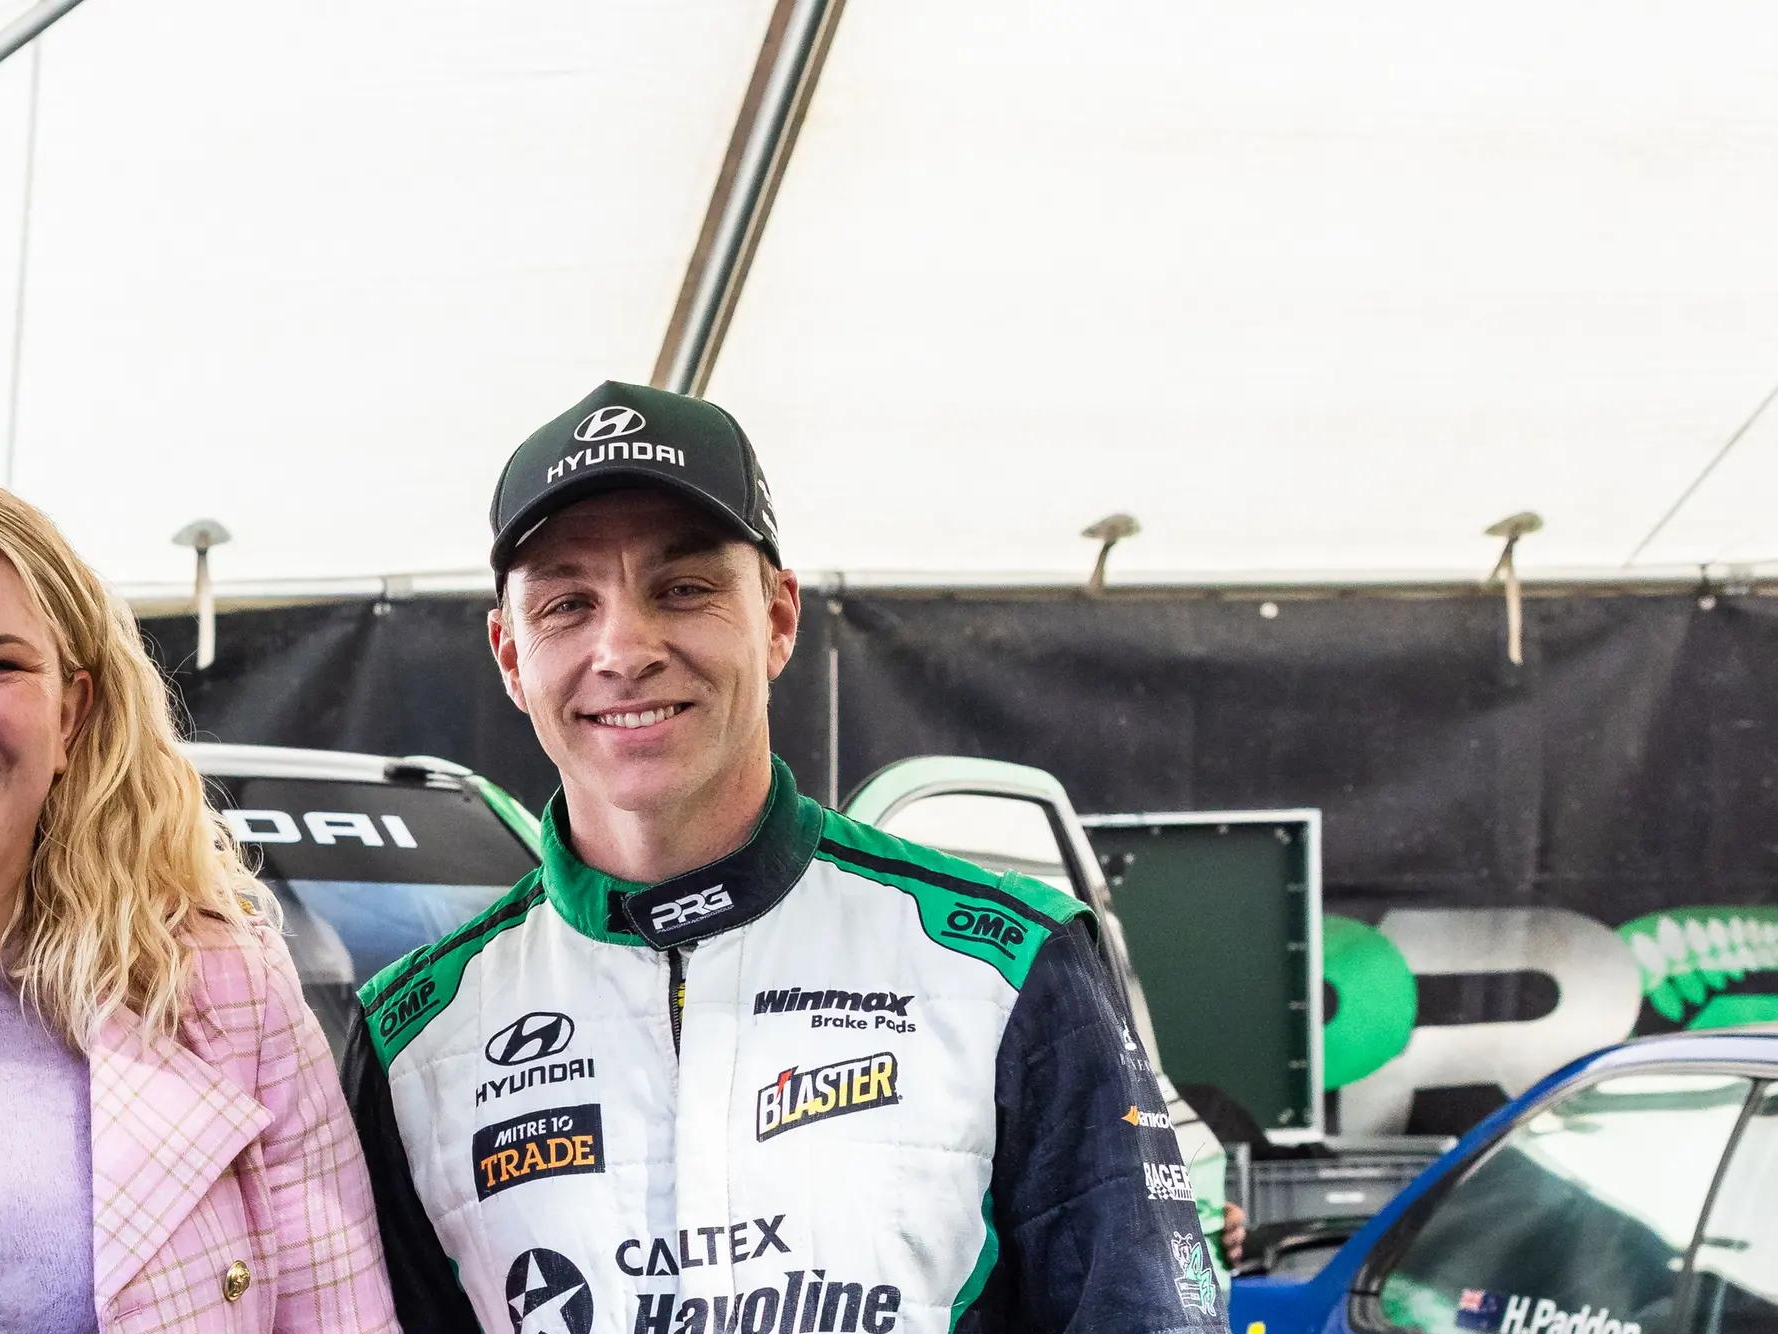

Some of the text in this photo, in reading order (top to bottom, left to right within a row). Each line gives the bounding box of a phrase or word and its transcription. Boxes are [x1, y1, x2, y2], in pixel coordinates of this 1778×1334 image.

[546, 442, 685, 484] HYUNDAI
[222, 808, 419, 849] DAI
[650, 883, 734, 930] PRG
[946, 909, 1025, 946] OMP
[380, 980, 436, 1037] OMP
[753, 986, 916, 1017] Winmax
[810, 1014, 917, 1034] Brake Pads
[475, 1058, 596, 1108] HYUNDAI
[494, 1114, 574, 1149] MITRE 10
[480, 1134, 595, 1188] TRADE
[615, 1213, 793, 1277] CALTEX
